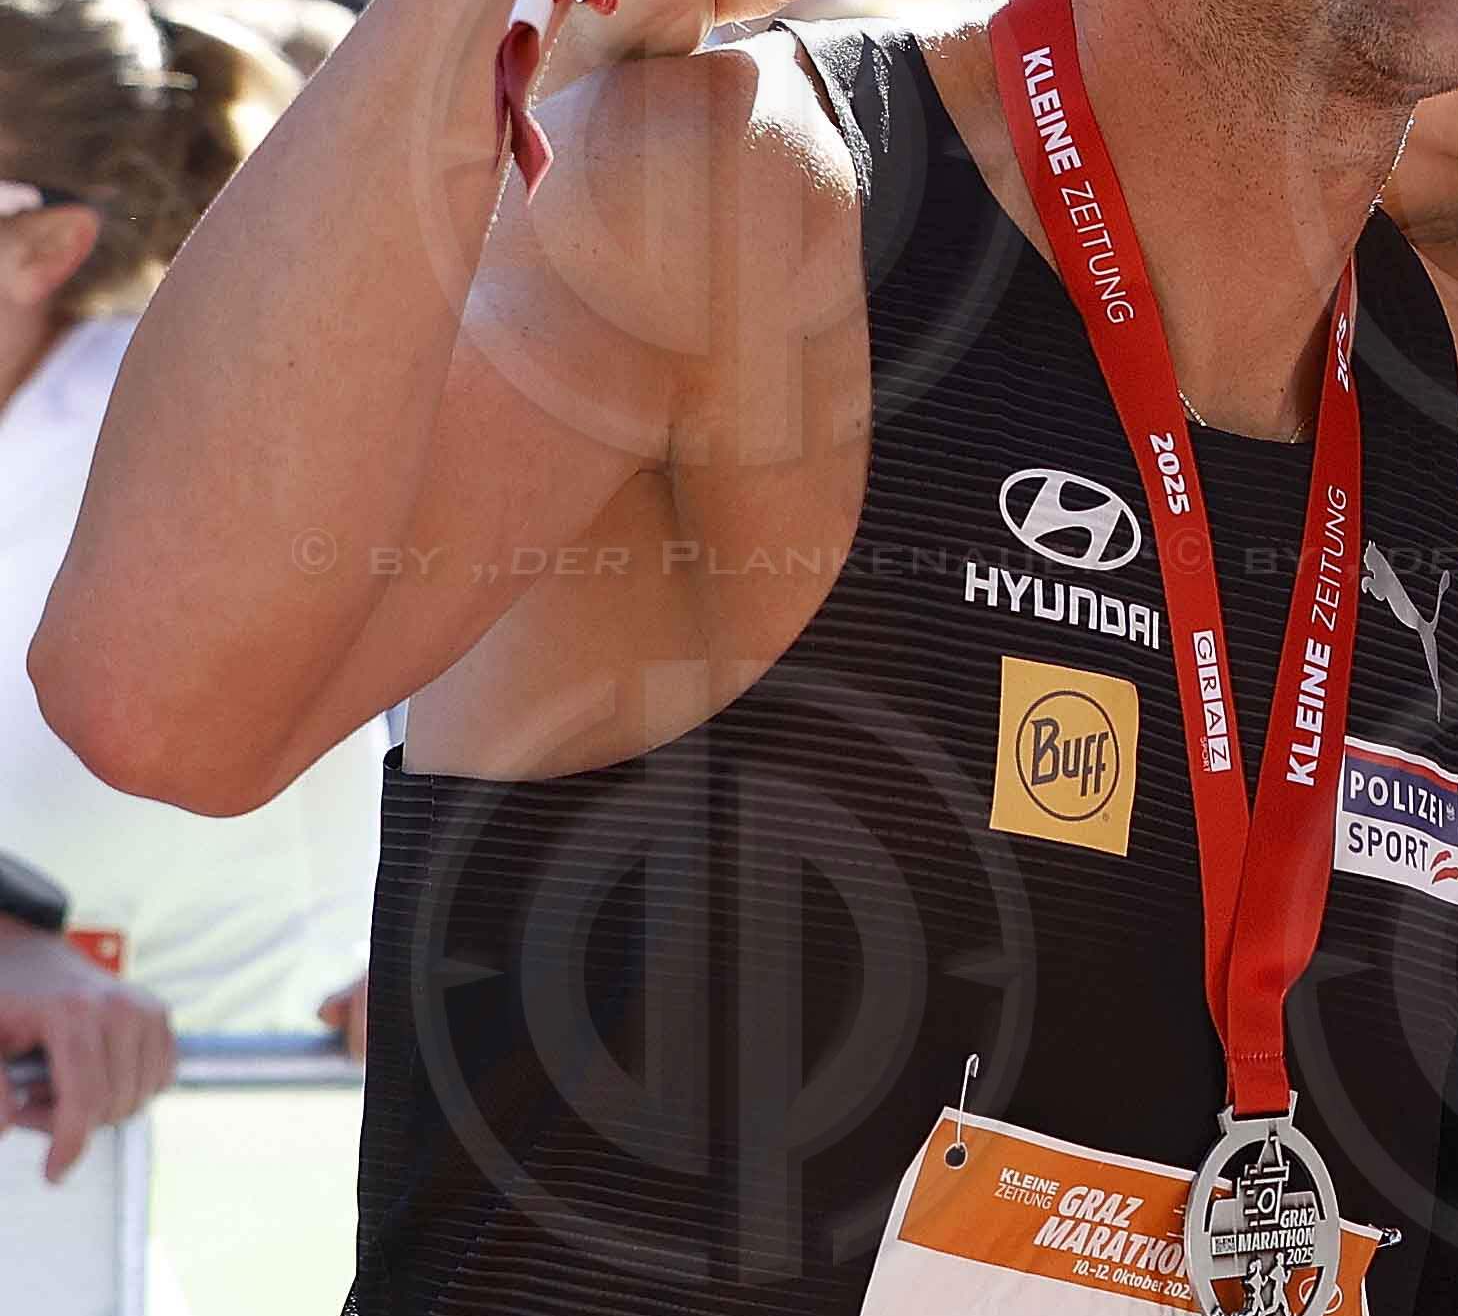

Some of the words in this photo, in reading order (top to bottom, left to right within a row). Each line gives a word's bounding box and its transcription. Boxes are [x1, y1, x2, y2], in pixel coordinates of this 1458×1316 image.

[1022, 46, 1082, 175] KLEINE
[1061, 181, 1134, 325] ZEITUNG
[1149, 432, 1190, 516] 2025
[965, 562, 1160, 649] HYUNDAI
[1286, 638, 1331, 785] KLEINE
[1311, 485, 1347, 632] ZEITUNG
[1194, 631, 1232, 772] GRAZ
[1349, 769, 1444, 829] POLIZEI
[1347, 823, 1431, 873] SPORT
[994, 1183, 1053, 1209] ZEITUNG
[1000, 1168, 1060, 1195] KLEINE
[1058, 1186, 1144, 1228] GRAZ
[1280, 1207, 1316, 1229] GRAZ
[1238, 1228, 1316, 1252] MARATHON
[1286, 1246, 1314, 1265] 2025
[1112, 1269, 1163, 1293] Oktober
[1164, 1281, 1192, 1300] 202
